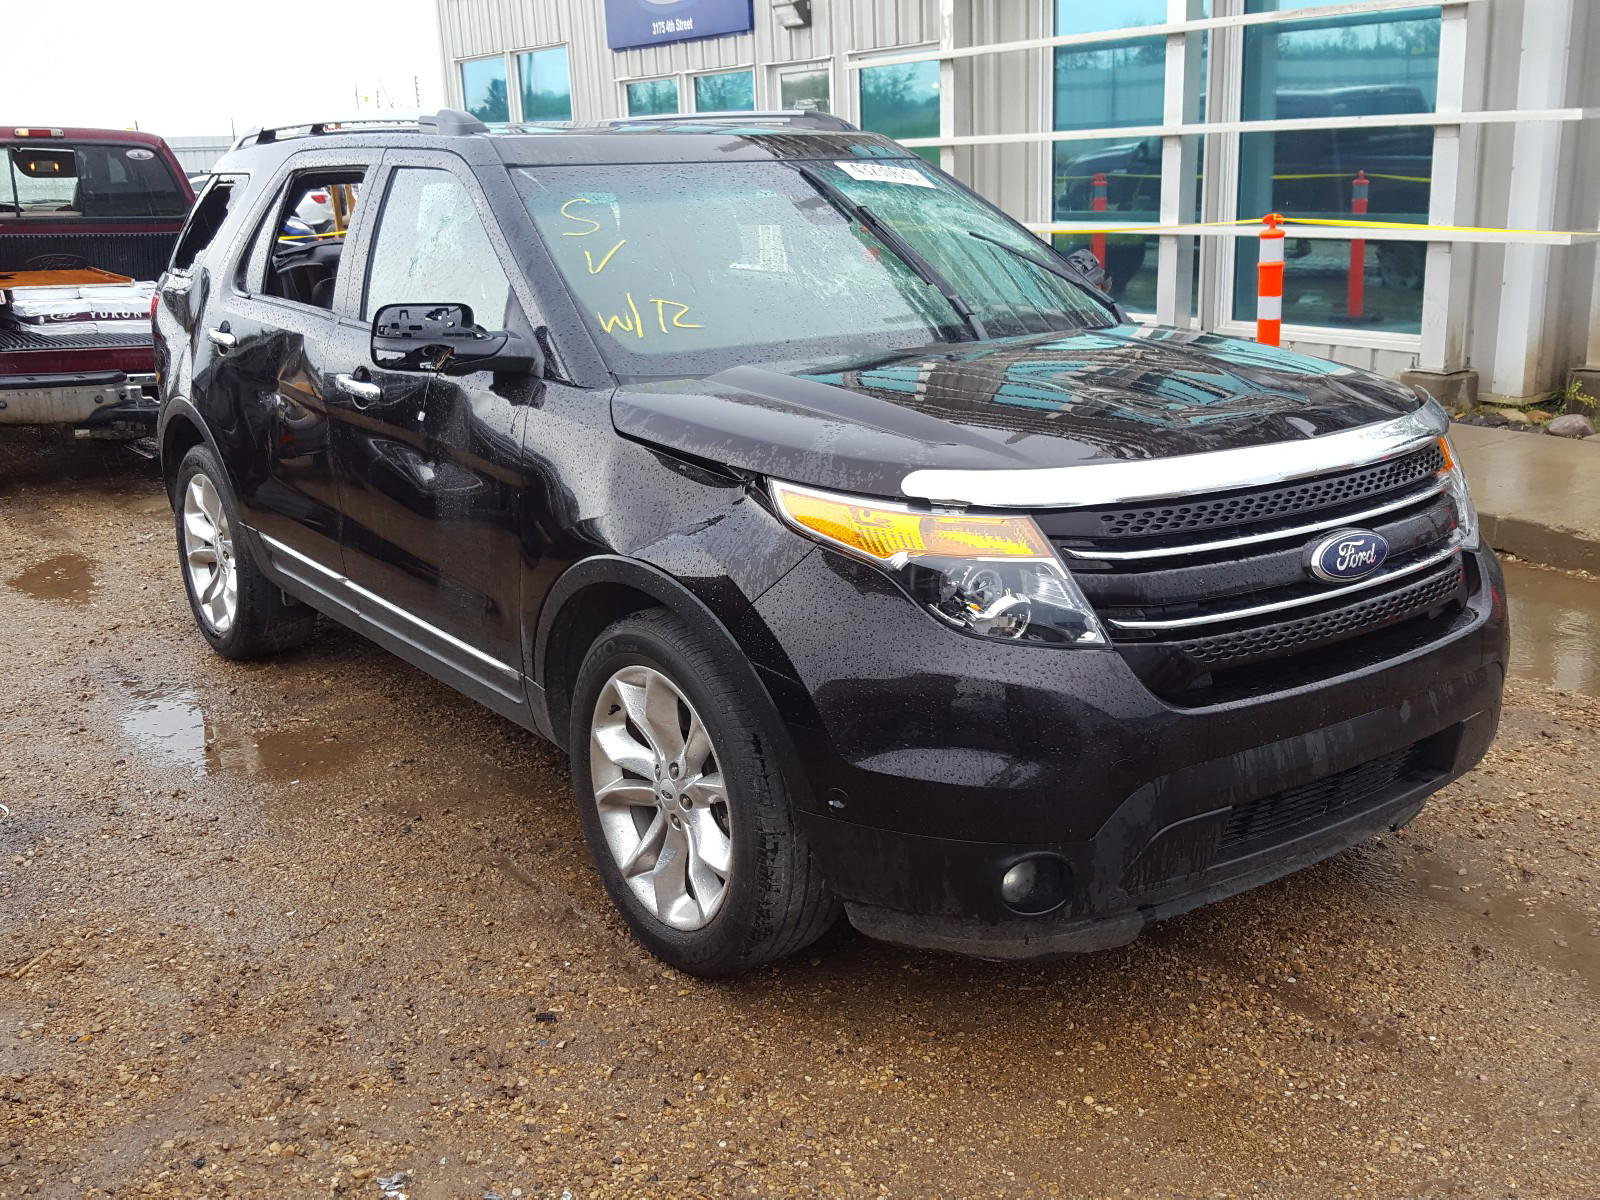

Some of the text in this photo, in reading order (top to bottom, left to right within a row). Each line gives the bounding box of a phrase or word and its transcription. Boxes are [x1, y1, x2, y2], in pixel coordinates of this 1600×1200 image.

[652, 16, 694, 35] 3175 4th Street
[560, 198, 600, 236] S
[89, 311, 143, 319] YUKON
[1336, 539, 1377, 571] Ford
